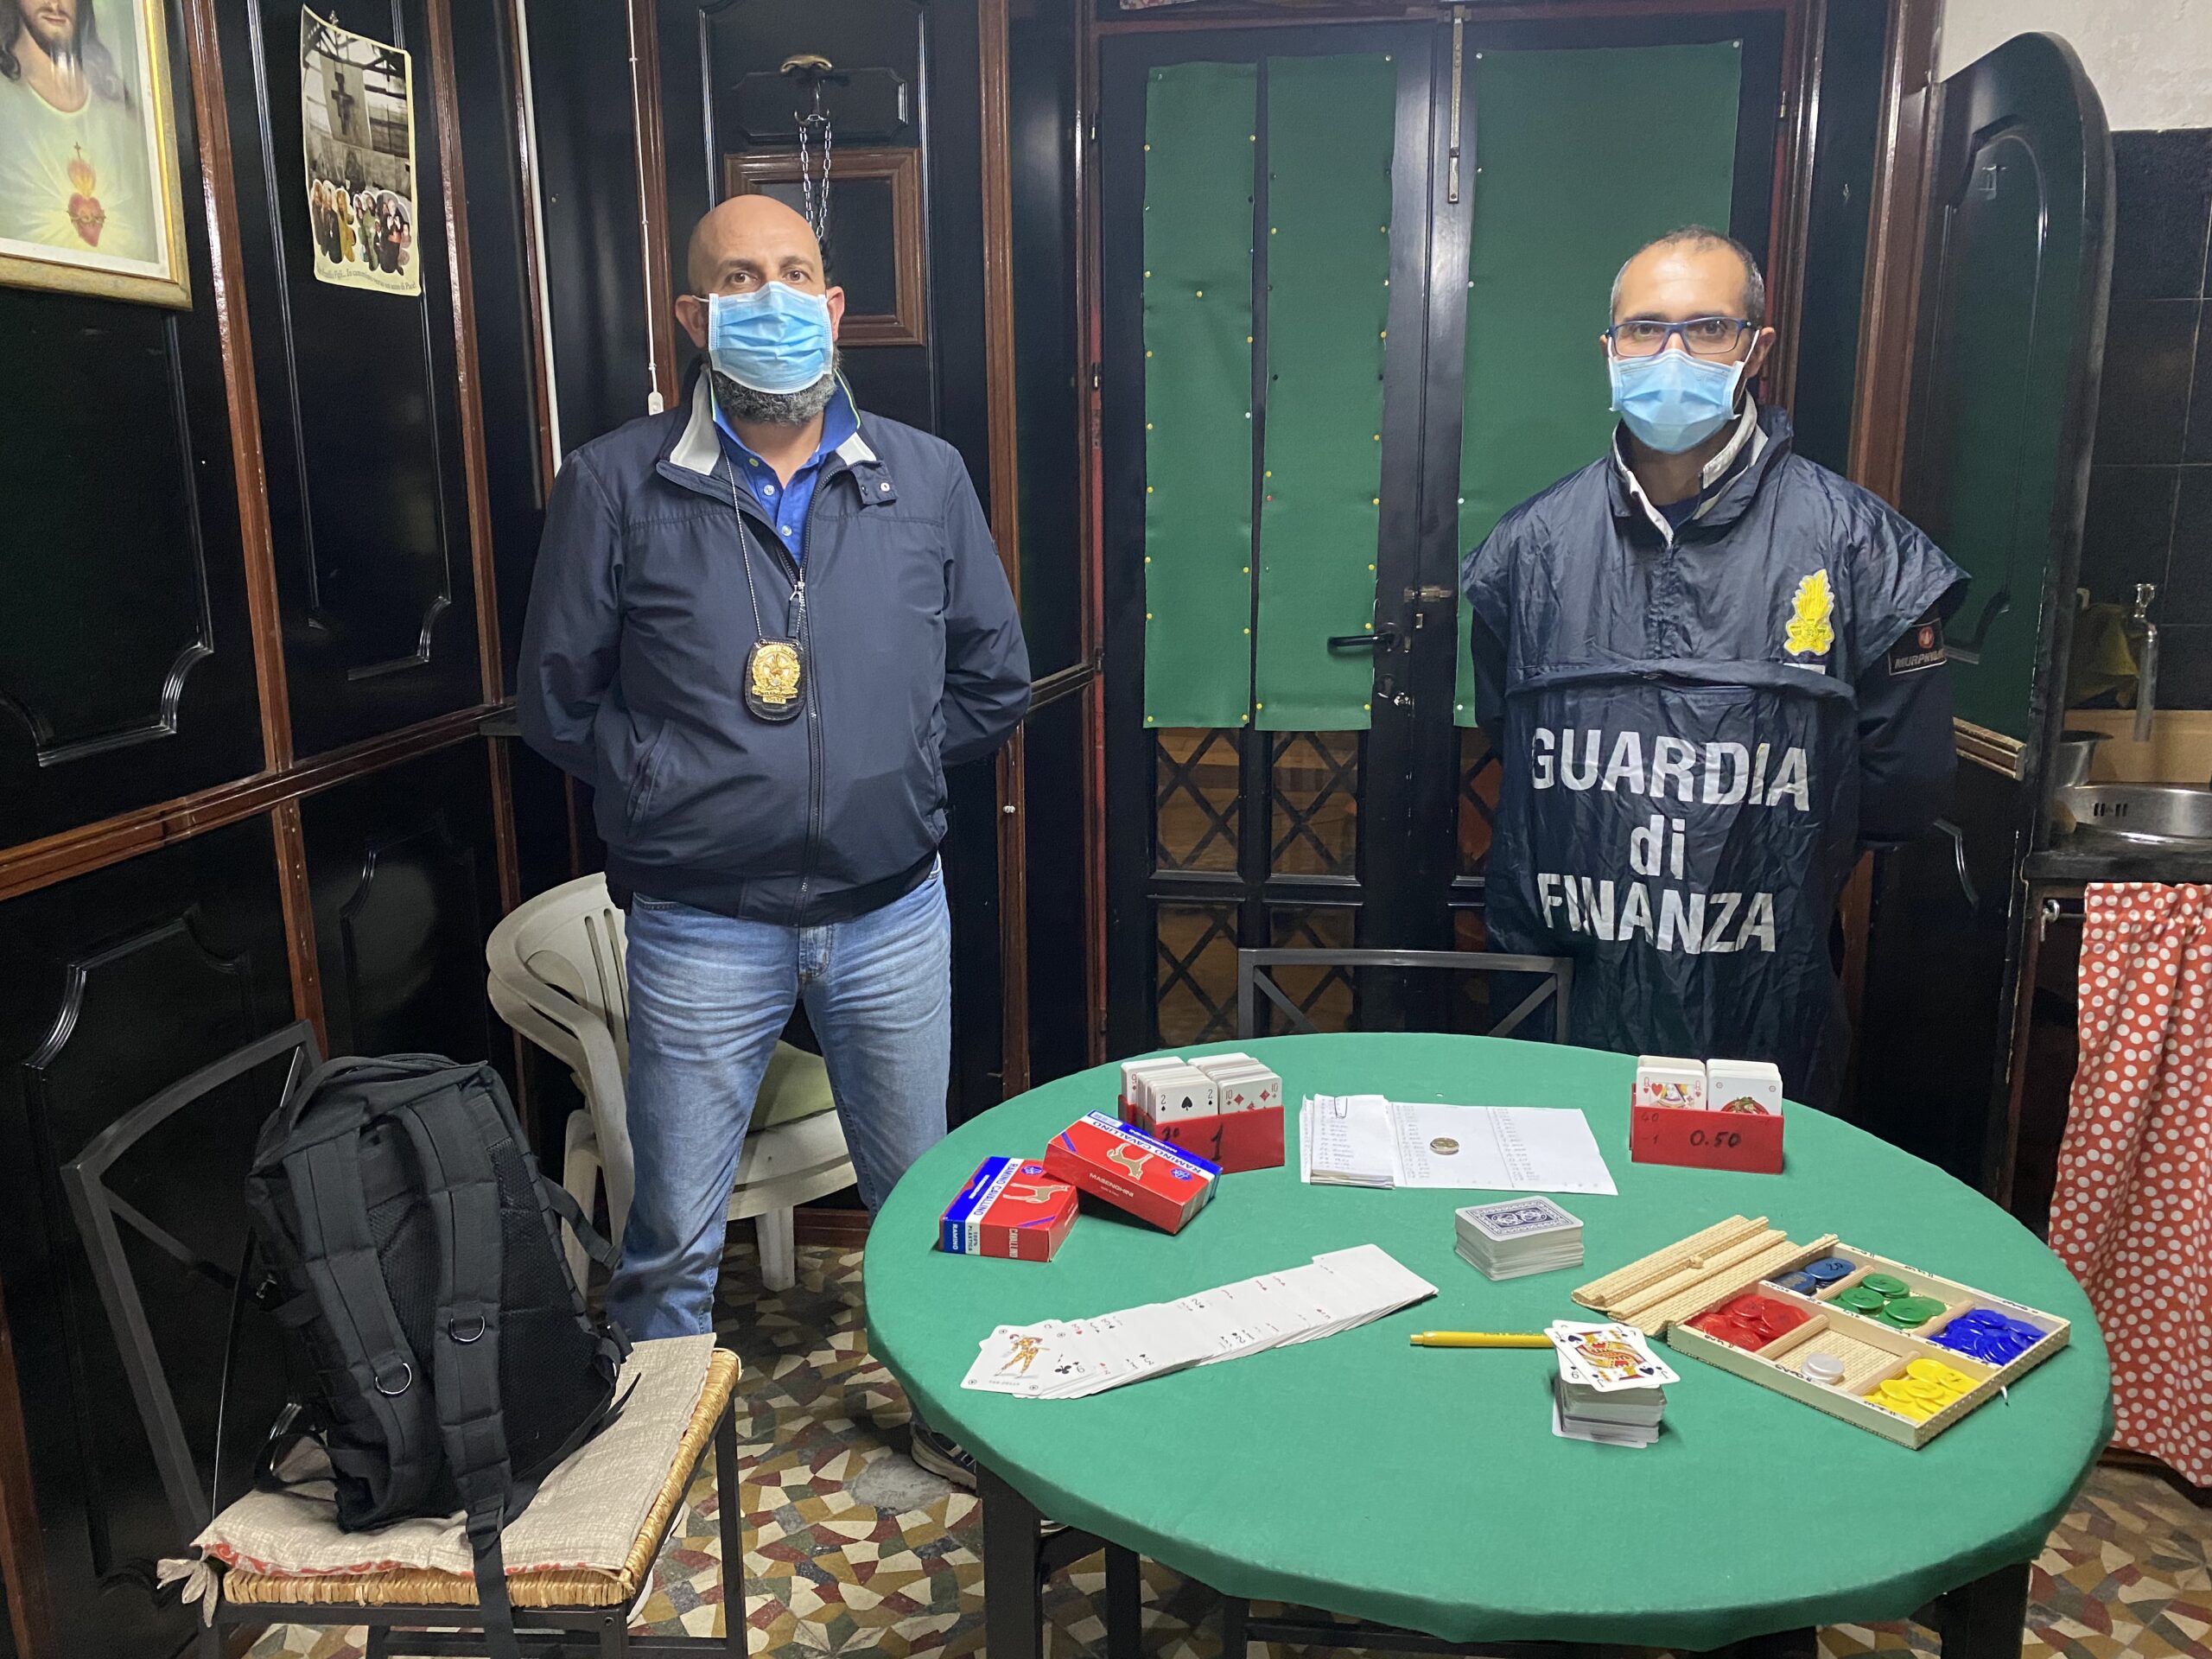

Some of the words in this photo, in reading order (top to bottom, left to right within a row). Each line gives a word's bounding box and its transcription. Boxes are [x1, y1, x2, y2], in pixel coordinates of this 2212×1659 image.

[1532, 728, 1810, 812] GUARDIA
[1630, 814, 1686, 880] di
[1536, 872, 1776, 955] FINANZA
[1225, 1089, 1233, 1100] 10
[1271, 1082, 1279, 1093] 10
[1092, 1121, 1152, 1150] CAVALLINO
[1689, 1129, 1742, 1148] 0.50
[996, 1162, 1019, 1185] RAMINO
[1154, 1149, 1202, 1173] RAMINO
[973, 1185, 1002, 1216] CAVALLINO
